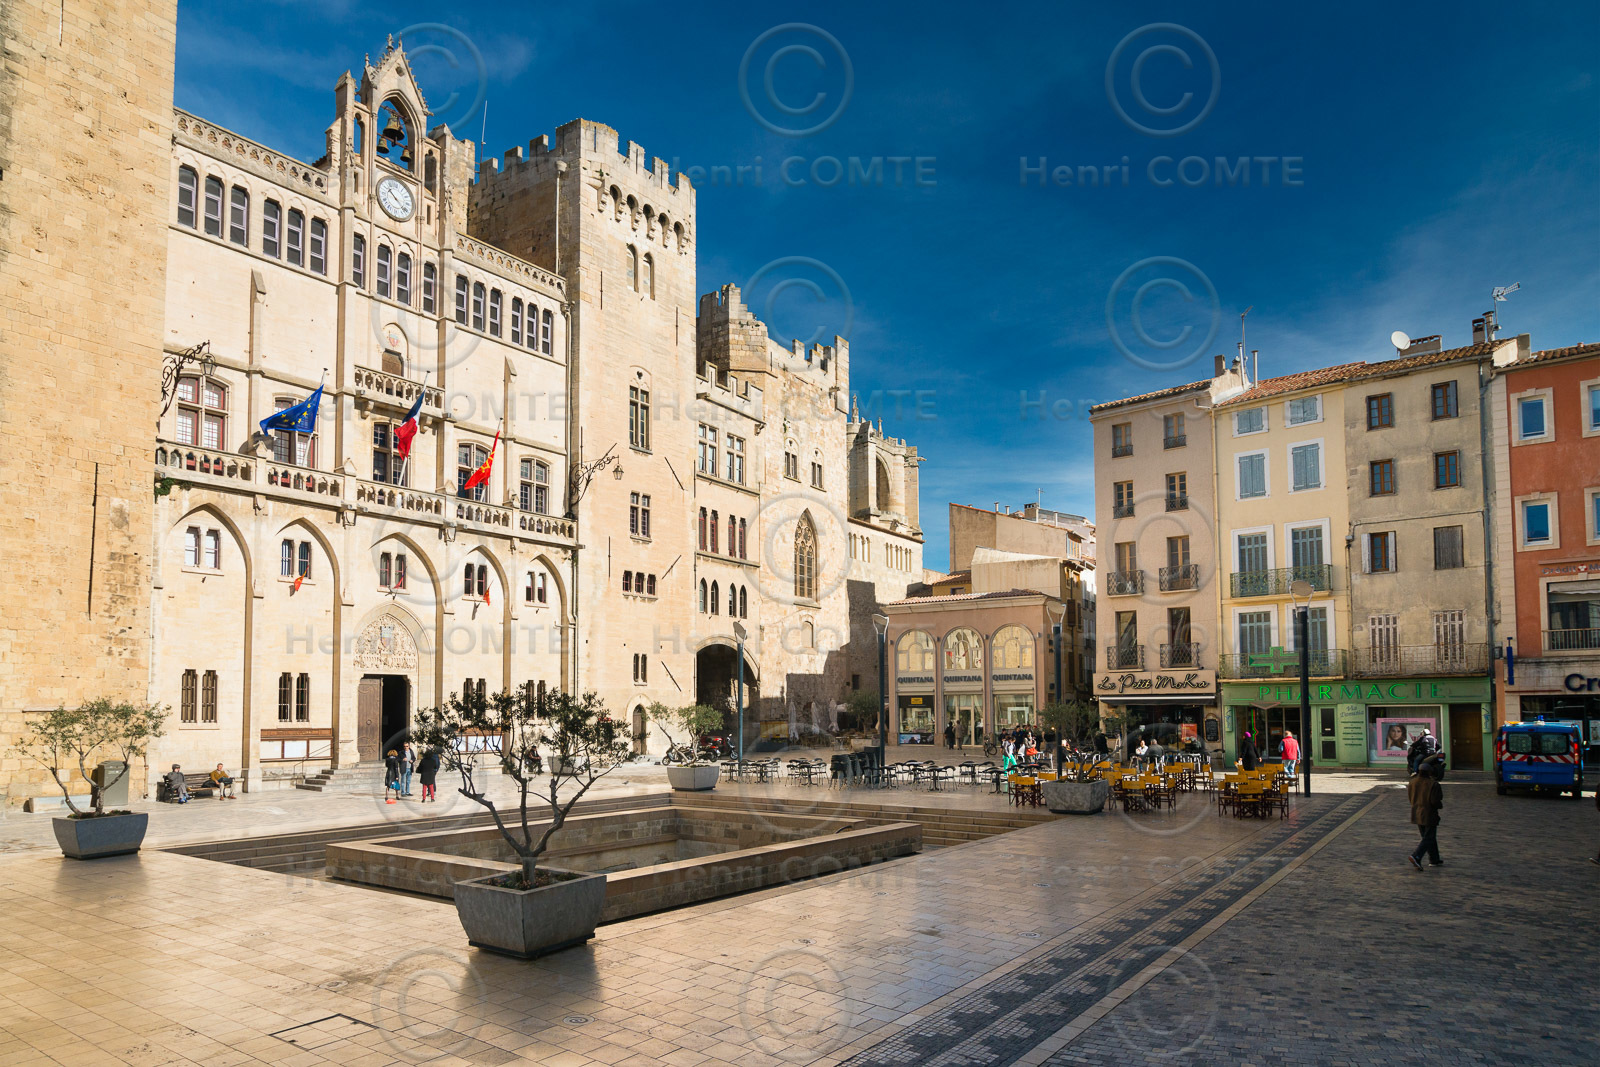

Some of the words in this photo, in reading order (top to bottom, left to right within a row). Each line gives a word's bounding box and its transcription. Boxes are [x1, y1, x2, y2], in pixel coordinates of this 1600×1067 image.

[897, 676, 935, 684] QUINTANA
[943, 675, 983, 683] QUINTANA
[992, 673, 1034, 681] QUINTANA
[1097, 676, 1116, 690] Le
[1118, 673, 1152, 693] Petit
[1564, 673, 1600, 692] Cr
